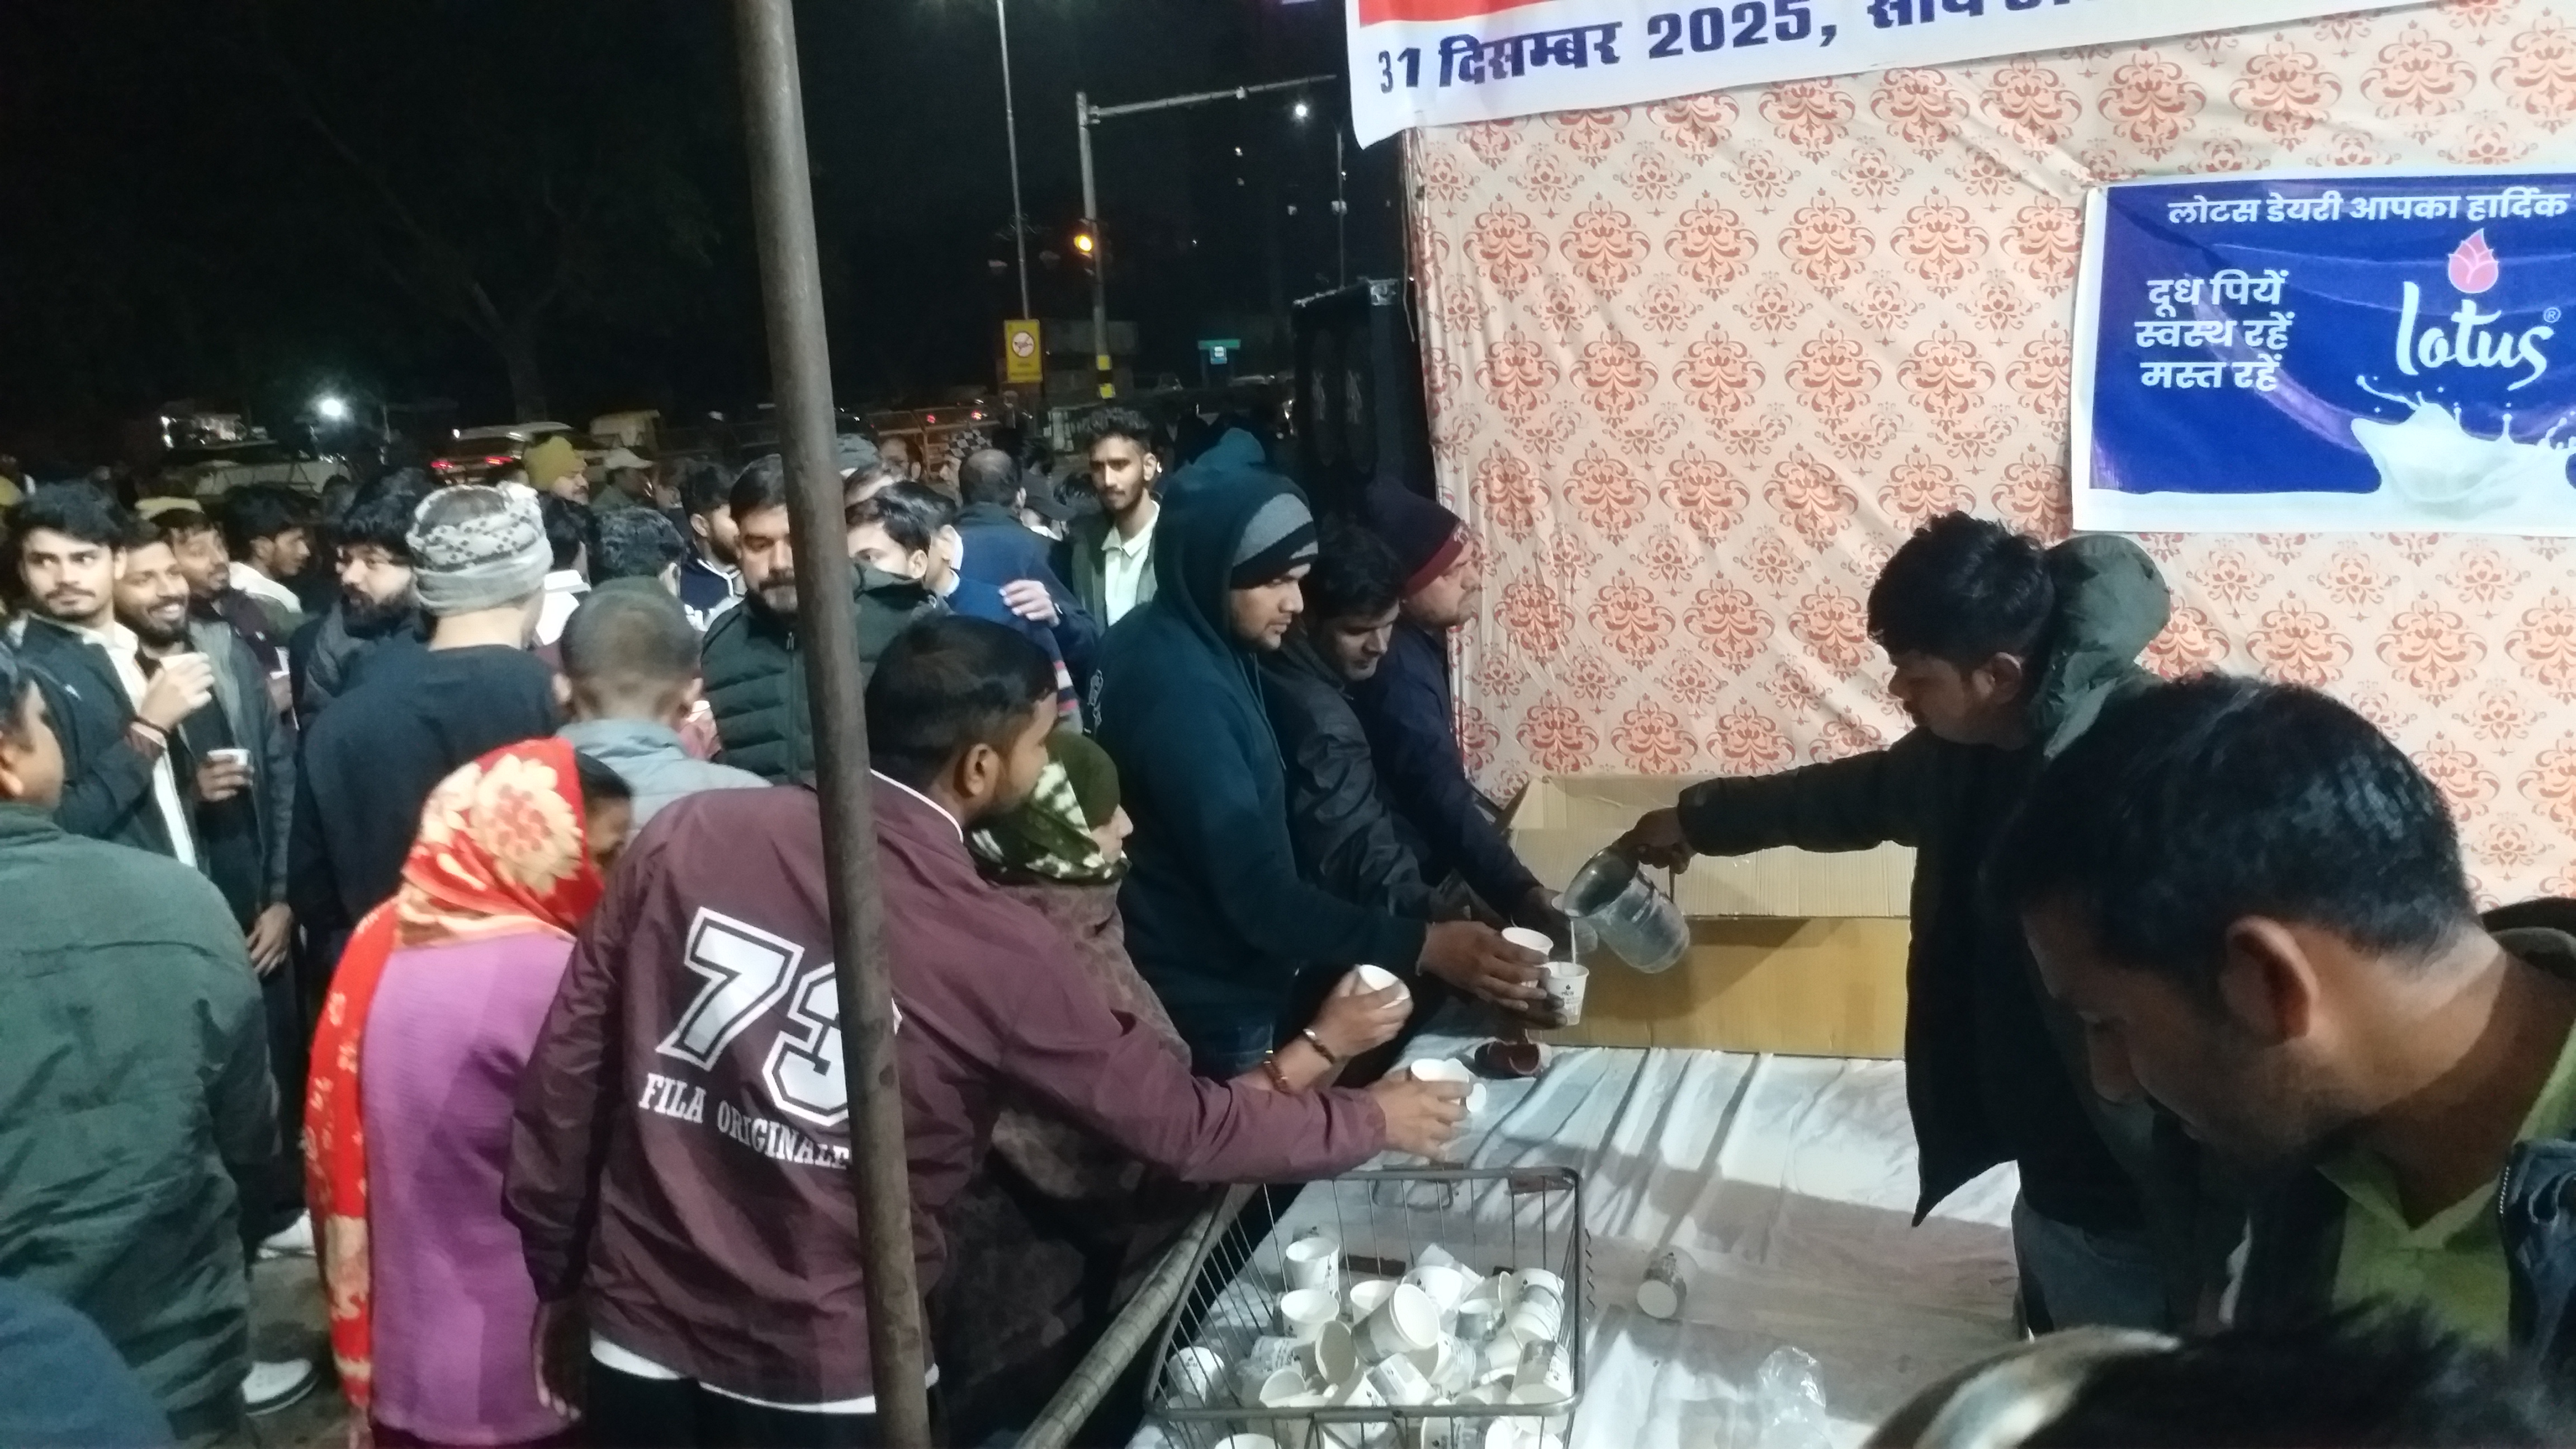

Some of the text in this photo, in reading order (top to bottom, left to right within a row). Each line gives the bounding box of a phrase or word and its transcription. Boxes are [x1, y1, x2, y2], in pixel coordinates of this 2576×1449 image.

[1377, 47, 1421, 94] 31
[1438, 21, 1622, 88] दिसम्बर
[1647, 0, 1837, 59] 2025,
[2167, 186, 2569, 224] लोटस डेयरी आपका हार्दिक
[2147, 268, 2289, 318] दूध पियें
[2134, 311, 2294, 350] स्वस्थ रहें
[2396, 281, 2555, 391] lotus
[2140, 353, 2282, 392] मस्त रहें
[638, 1073, 708, 1124] FILA
